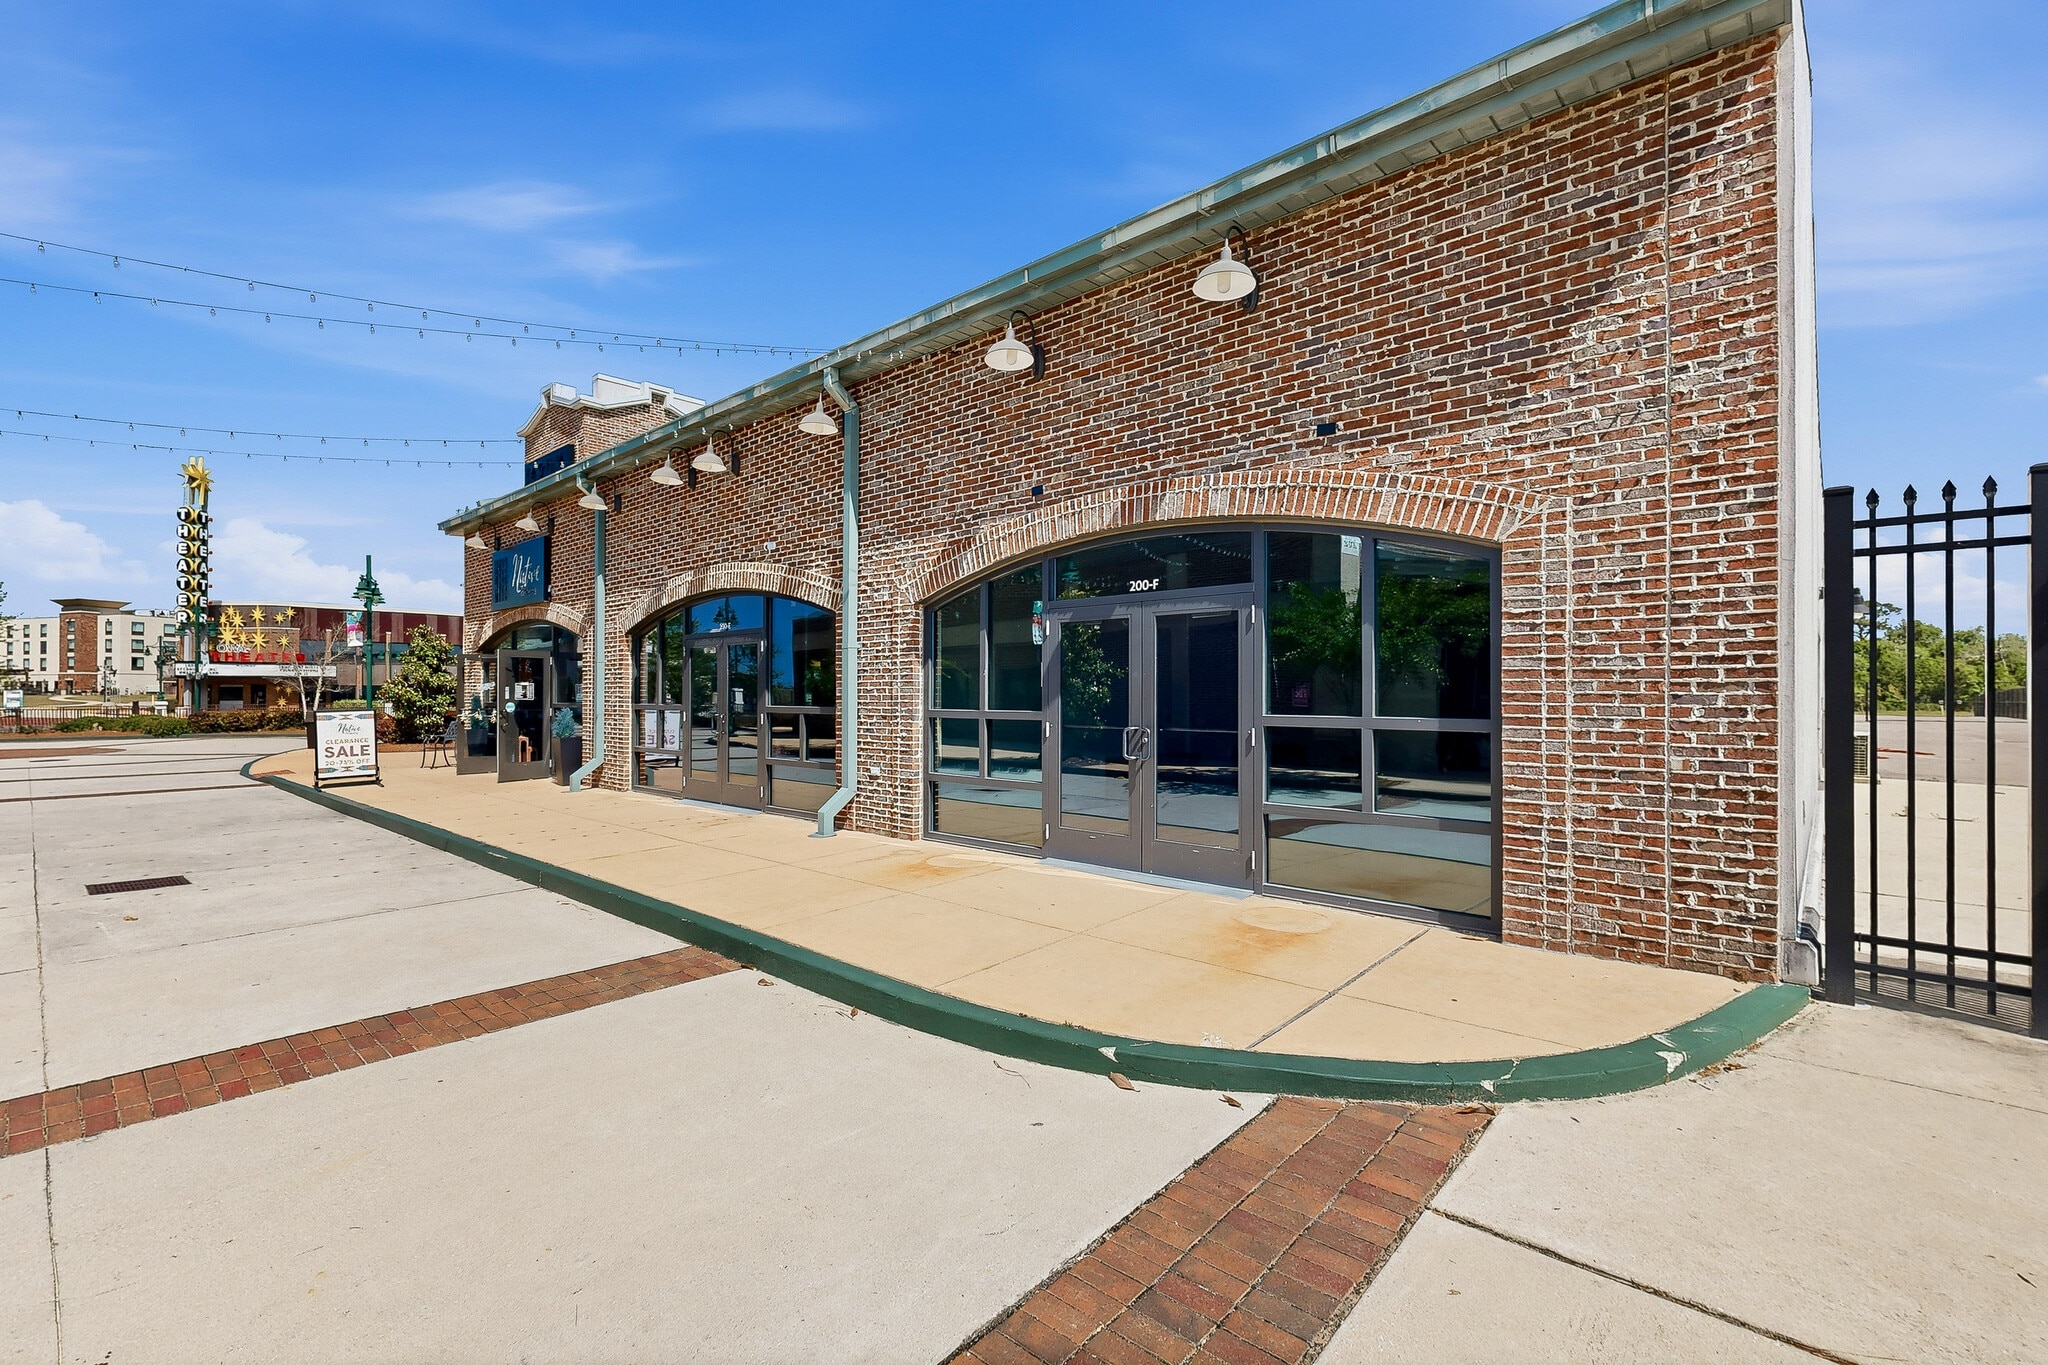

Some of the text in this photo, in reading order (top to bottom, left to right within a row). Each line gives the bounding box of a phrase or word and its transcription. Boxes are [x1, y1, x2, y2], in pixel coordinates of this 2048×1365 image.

[177, 508, 188, 623] THEATER
[199, 511, 208, 624] THEATER
[1129, 578, 1160, 592] 200-F
[325, 737, 369, 745] CLEARANCE
[324, 744, 371, 758] SALE
